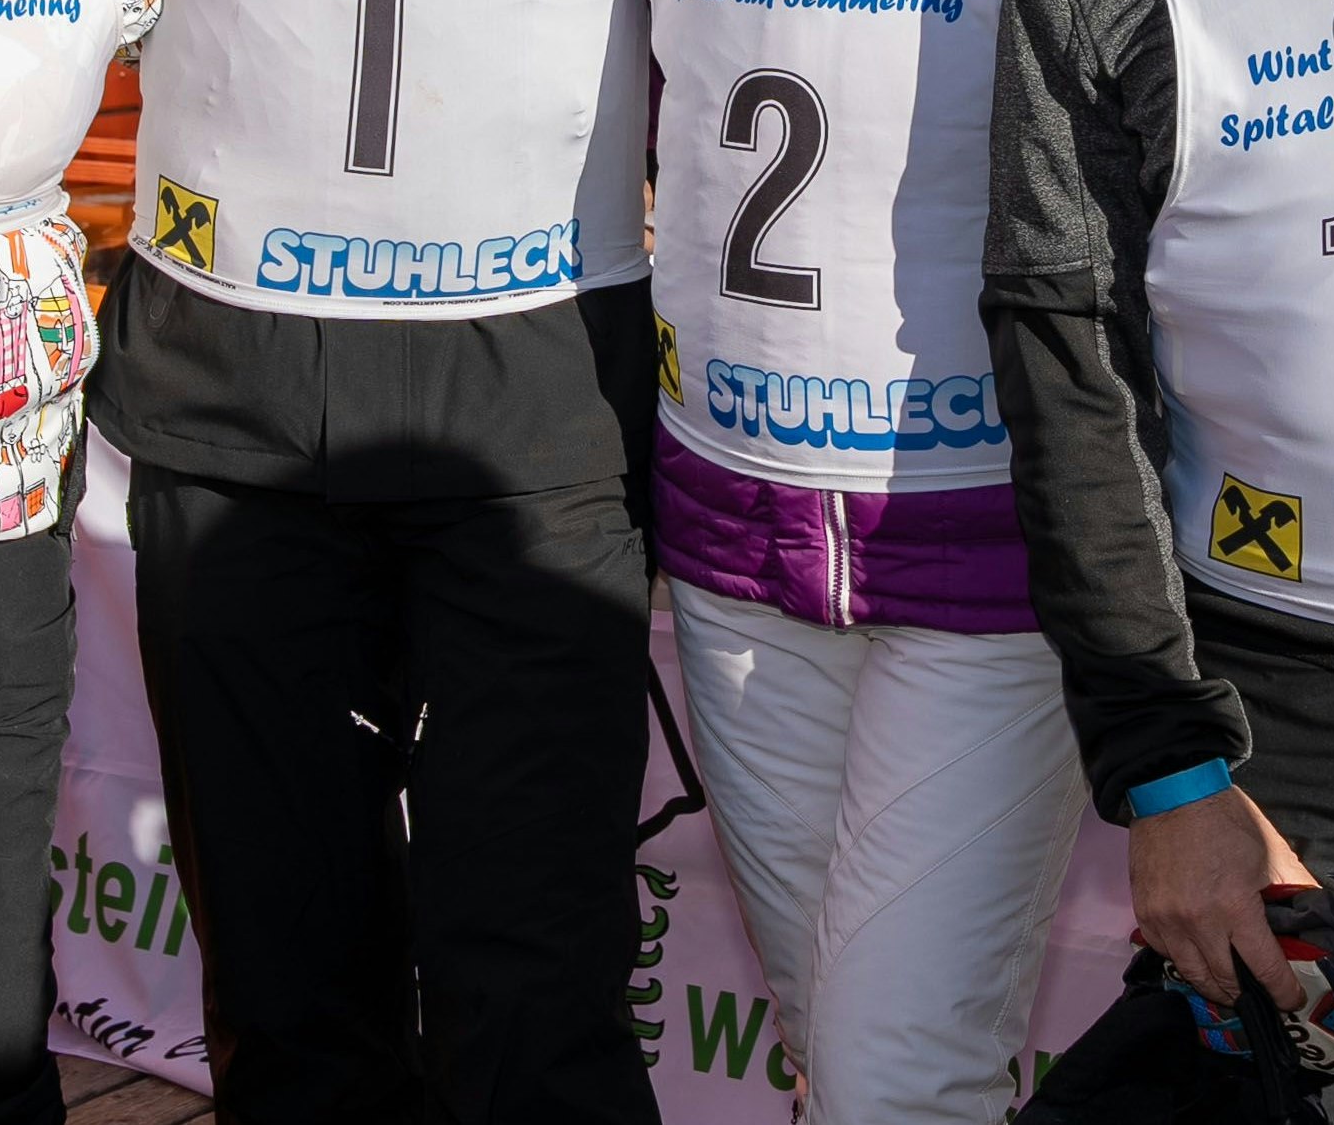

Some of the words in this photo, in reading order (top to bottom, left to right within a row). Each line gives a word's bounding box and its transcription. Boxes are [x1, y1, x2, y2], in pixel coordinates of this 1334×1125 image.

[1220, 94, 1334, 151] Spital
[719, 67, 829, 312] 2
[256, 217, 584, 299] STUHLECK
